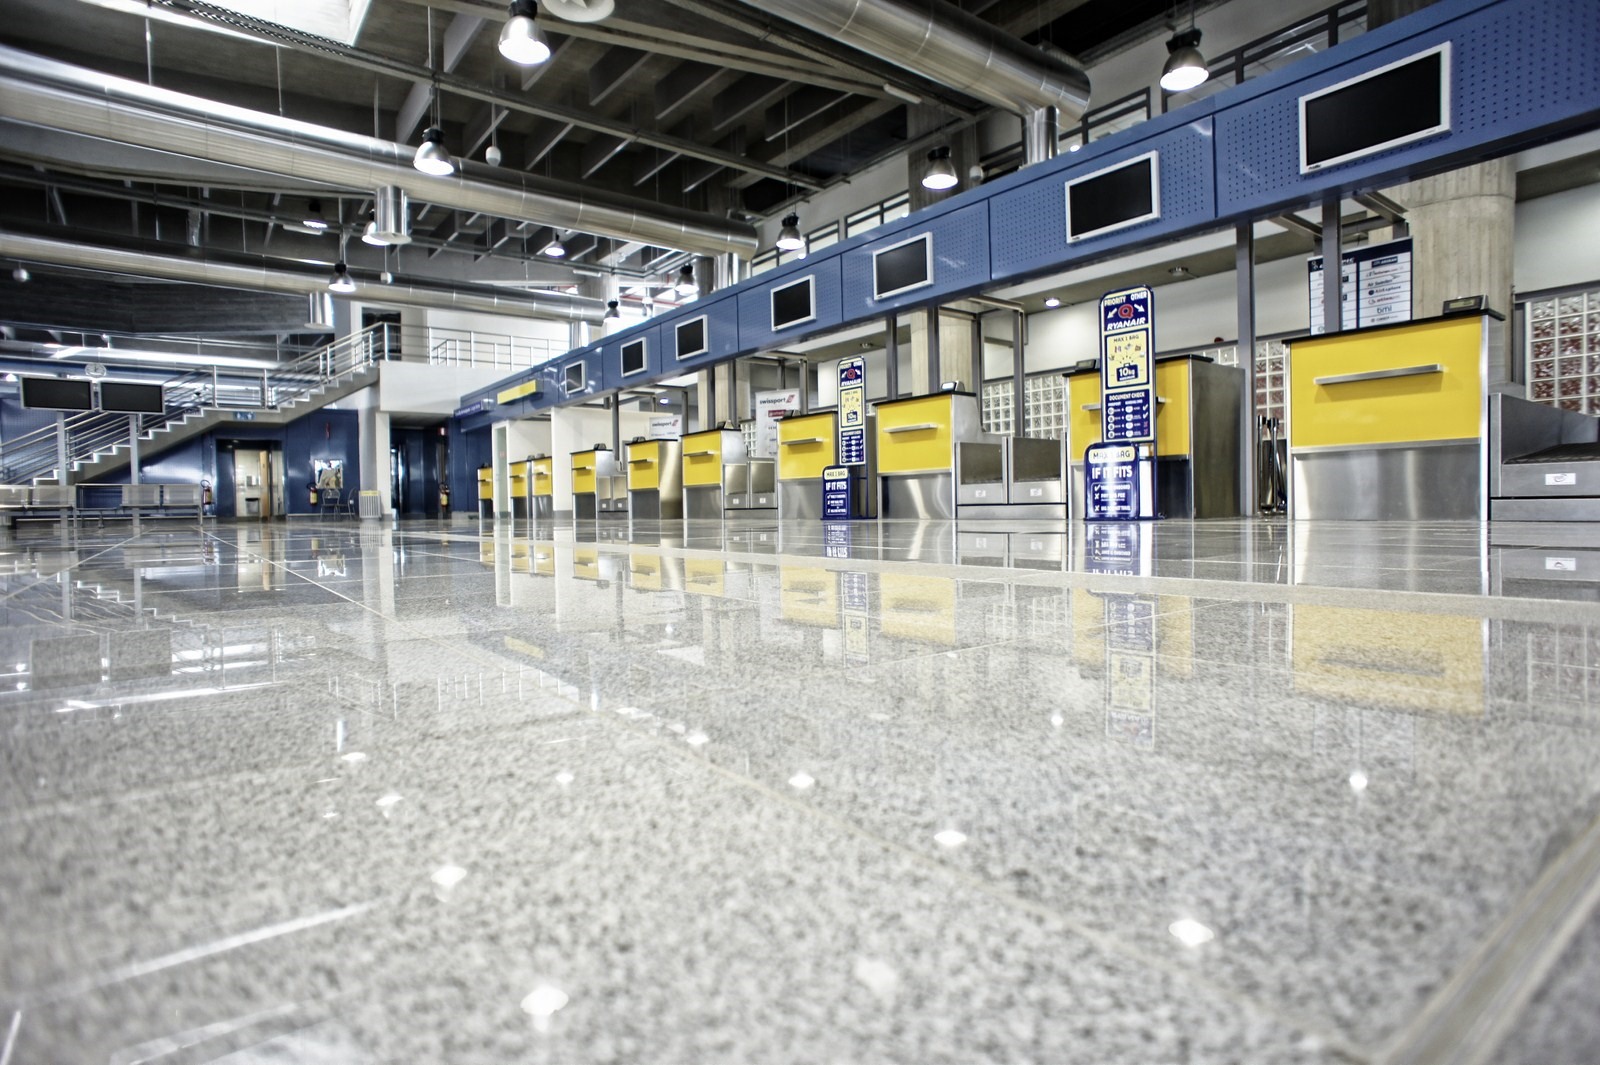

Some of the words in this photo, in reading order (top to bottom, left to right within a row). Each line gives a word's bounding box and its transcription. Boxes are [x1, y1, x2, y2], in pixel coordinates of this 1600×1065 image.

[1105, 296, 1126, 306] PRIORITY
[1131, 291, 1147, 301] OTHER
[1377, 305, 1392, 313] bmi
[1107, 317, 1146, 331] RYANAIR
[1092, 467, 1101, 479] IF
[1113, 466, 1133, 479] FITS
[826, 482, 831, 491] IF
[831, 482, 836, 490] IT
[837, 481, 847, 490] FITS
